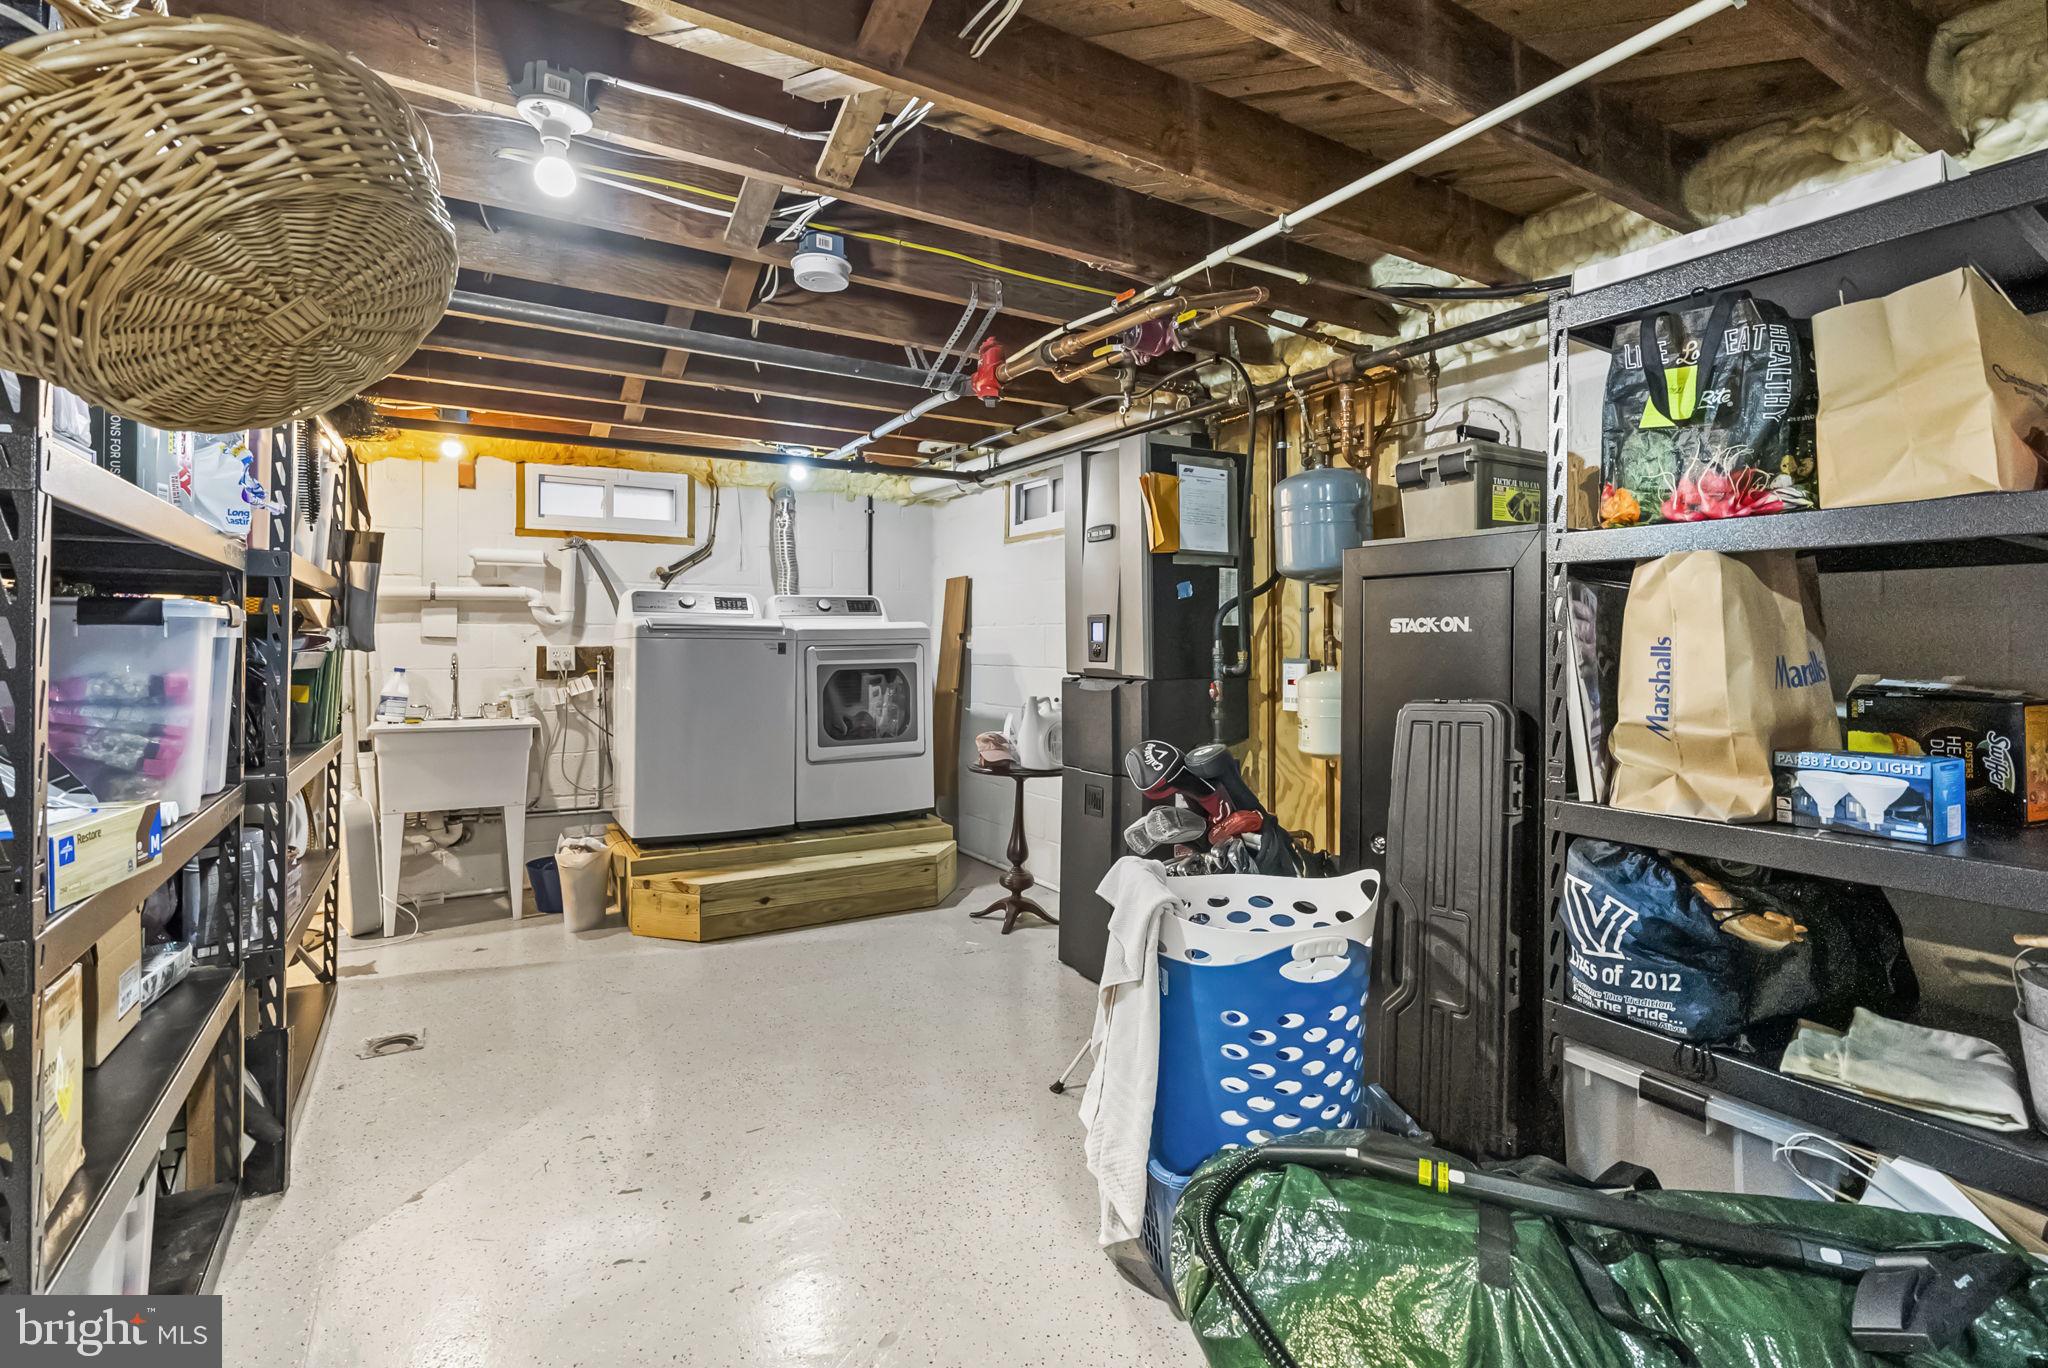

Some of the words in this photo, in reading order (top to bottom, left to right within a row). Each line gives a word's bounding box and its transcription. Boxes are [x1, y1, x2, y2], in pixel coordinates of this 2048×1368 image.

[1624, 340, 1669, 369] LIE
[1675, 340, 1700, 365] Lo
[1724, 324, 1767, 355] EAT
[1763, 324, 1791, 422] HEALTHY
[110, 438, 121, 458] FOR
[110, 461, 121, 475] US
[227, 508, 250, 517] Long
[1390, 616, 1470, 633] STACK-ON
[1646, 636, 1672, 741] Marshalls
[1946, 736, 1962, 757] HE
[1777, 754, 1819, 767] PAR38
[1823, 757, 1873, 771] FLOOD
[1877, 762, 1926, 776] LIGHT
[1965, 741, 1974, 778] DUSTERS
[1982, 730, 2011, 790] Swiffer
[76, 829, 102, 844] Restore
[150, 833, 160, 853] M
[1630, 969, 1682, 992] 2012
[1594, 998, 1621, 1013] The
